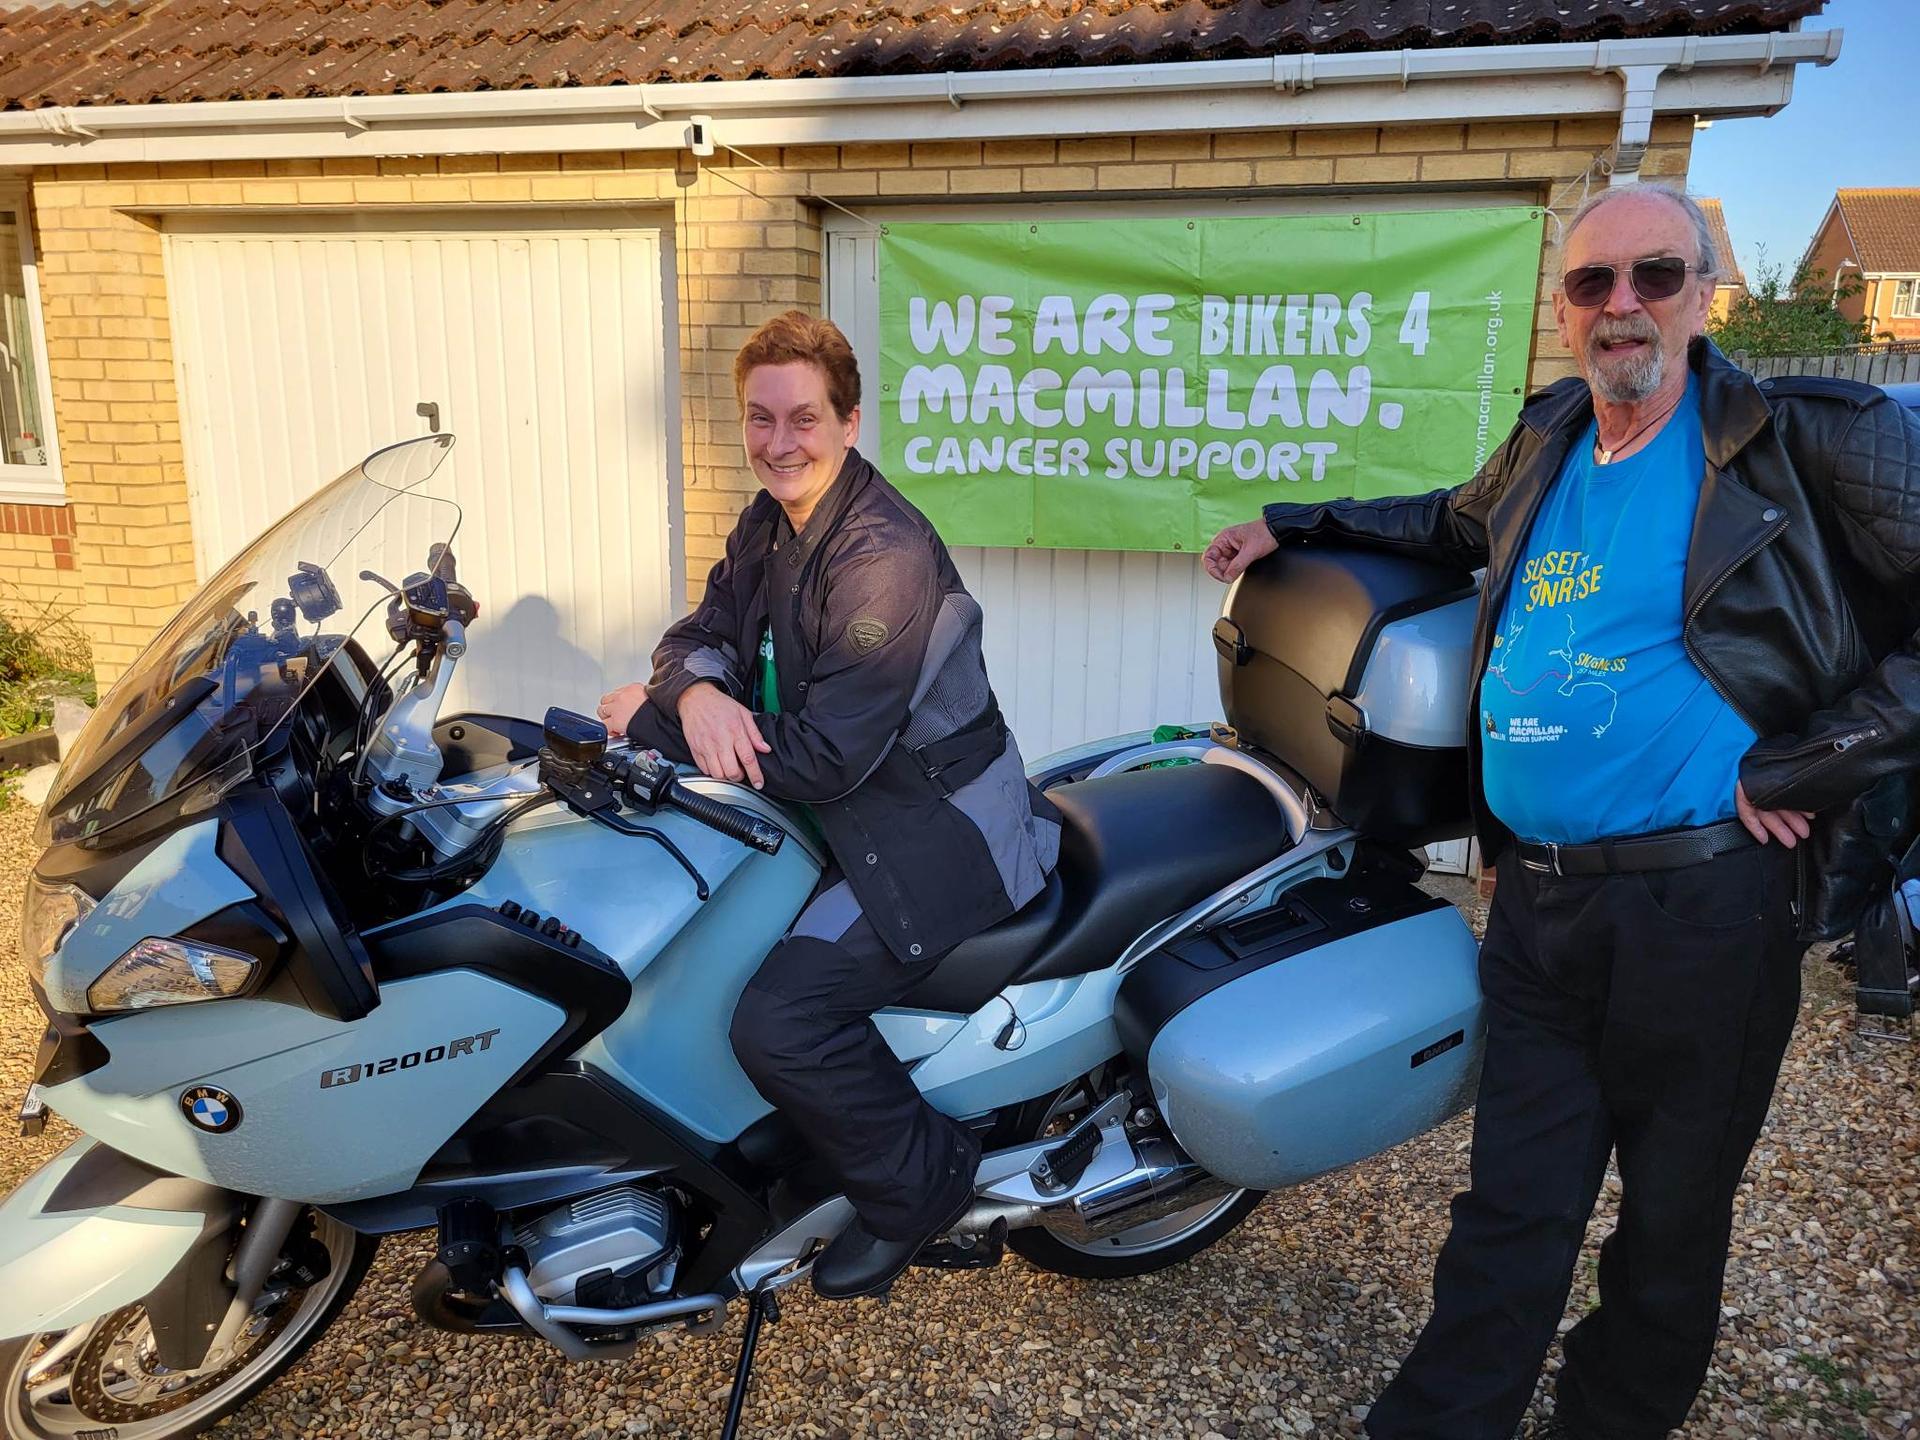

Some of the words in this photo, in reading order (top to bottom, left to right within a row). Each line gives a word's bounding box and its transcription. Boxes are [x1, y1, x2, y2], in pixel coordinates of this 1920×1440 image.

[908, 294, 1016, 356] WE
[1032, 293, 1177, 356] ARE
[1200, 290, 1372, 357] BIKERS
[1398, 291, 1431, 356] 4
[898, 364, 1404, 430] MACMILLAN.
[1473, 289, 1503, 476] ww.macmillan.org.uk
[904, 436, 1091, 477] CANCER
[1103, 437, 1338, 482] SUPPORT
[1509, 717, 1521, 727] WE
[1522, 717, 1539, 727] ARE
[1530, 734, 1560, 743] SUPPORT
[184, 1089, 230, 1107] BMW
